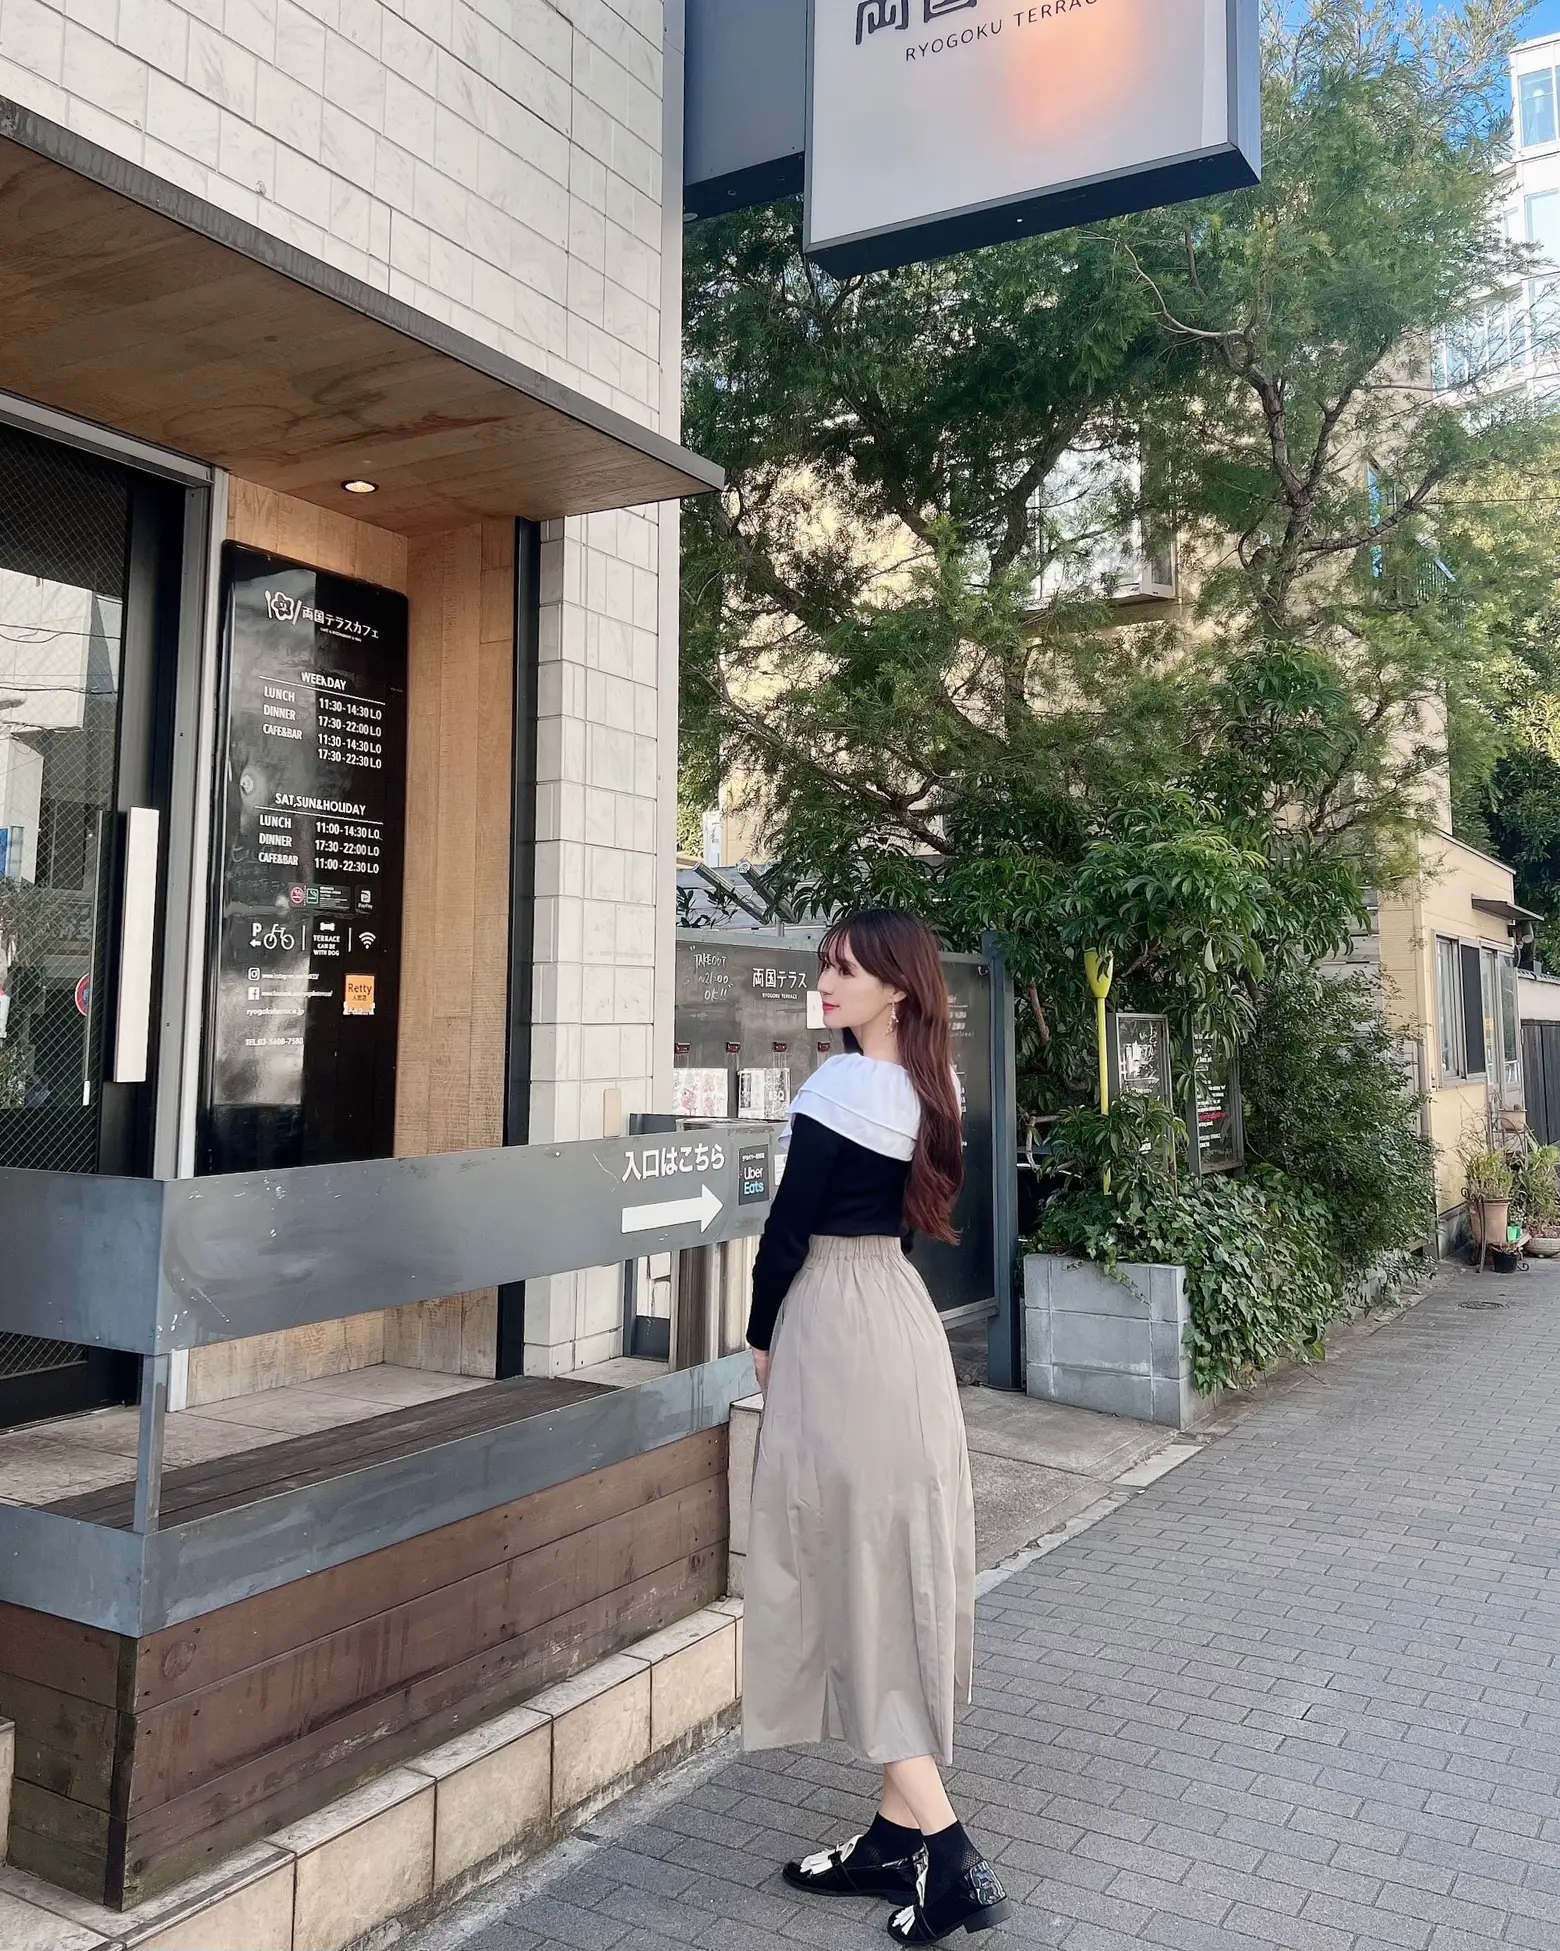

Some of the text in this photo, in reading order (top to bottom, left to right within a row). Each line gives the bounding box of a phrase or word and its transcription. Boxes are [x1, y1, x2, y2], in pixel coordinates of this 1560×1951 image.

[905, 19, 1003, 61] RYOGOKU
[302, 605, 379, 639] 両国テラスカフェ
[301, 671, 347, 690] WEEKDAY
[264, 686, 295, 702] LUNCH
[319, 698, 369, 718] 11:30-14:30
[263, 704, 296, 720] DINNER
[318, 715, 369, 735] 17:30-22:00
[263, 724, 303, 740] CAFE&BAR
[318, 733, 369, 752] 11:30-14:30
[318, 748, 369, 767] 17:30-22:30
[275, 792, 366, 816] SAT,SUN&HOLIDAY
[260, 814, 291, 829] LUNCH
[316, 821, 367, 838] 11:00-14:30
[259, 832, 292, 847] DINNER
[315, 839, 367, 856] 17:30-22:00
[258, 852, 299, 866] CAFE&BAR
[315, 857, 367, 873] 11:00-22:30
[252, 922, 262, 937] P
[313, 934, 340, 943] TERRACE
[347, 983, 373, 996] Retty
[752, 967, 808, 989] 両国テラス
[621, 1142, 725, 1183] 入口はこちら
[743, 1166, 764, 1180] Uber
[743, 1181, 765, 1195] Eats
